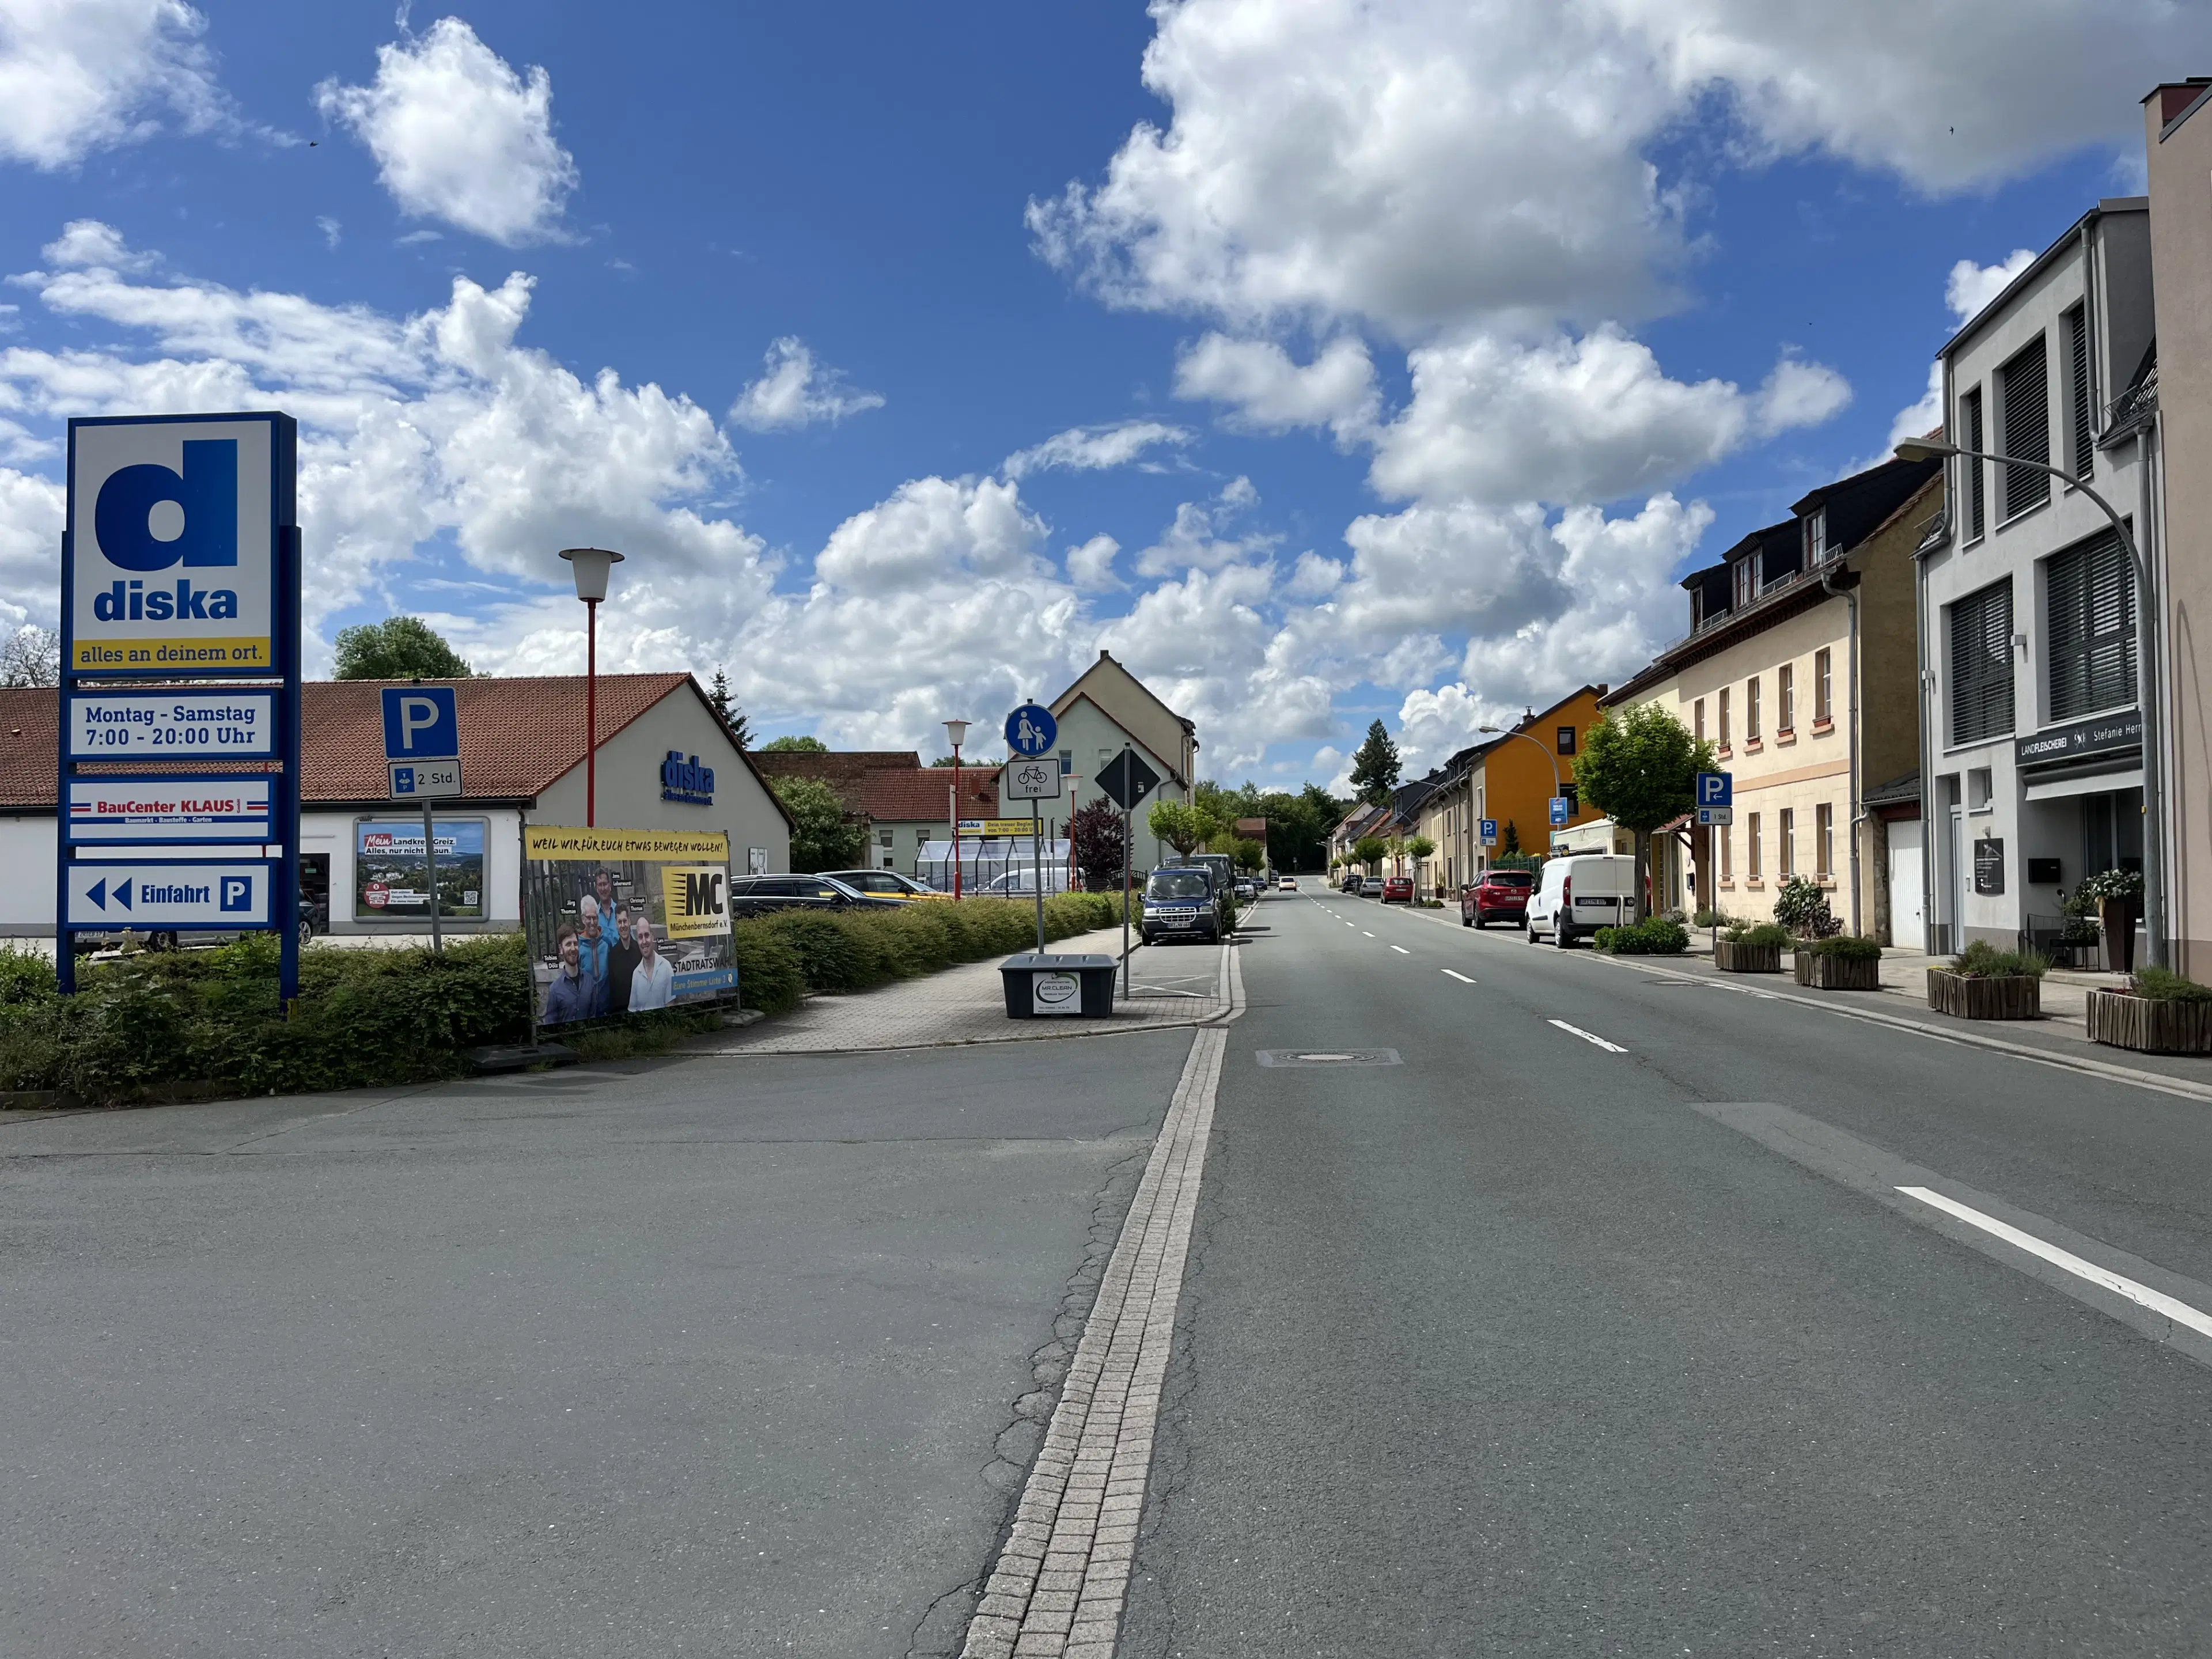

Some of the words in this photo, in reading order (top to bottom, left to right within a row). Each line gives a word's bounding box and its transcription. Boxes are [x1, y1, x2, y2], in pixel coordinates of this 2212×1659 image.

[95, 439, 237, 571] d
[94, 579, 237, 621] diska
[81, 647, 123, 662] alles
[129, 650, 150, 661] an
[157, 645, 226, 661] deinem
[232, 645, 262, 660] ort.
[86, 707, 154, 725] Montag
[173, 706, 255, 724] Samstag
[400, 697, 439, 749] P
[86, 729, 129, 745] 7:00
[153, 728, 209, 744] 20:00
[217, 728, 255, 744] Uhr
[2021, 737, 2067, 756] LANDFLEISCHEREI
[2094, 726, 2122, 741] Stefanie
[418, 774, 425, 785] 2
[432, 772, 456, 783] Std.
[661, 750, 714, 793] diska
[1025, 785, 1041, 793] frei
[1706, 777, 1724, 801] P
[97, 800, 176, 813] BauCenter
[181, 800, 234, 812] KLAUS
[1484, 822, 1493, 834] P
[366, 835, 391, 847] Mein
[533, 838, 558, 850] WEIL
[560, 838, 581, 851] WIR
[582, 836, 600, 851] FÜR
[601, 840, 623, 852] EUCH
[626, 841, 651, 852] ETWAS
[654, 841, 689, 854] BEWEGEN
[691, 842, 723, 853] WOLLEN!
[142, 885, 210, 903] Einfahrt
[227, 881, 245, 905] P
[685, 873, 723, 916] MC
[671, 920, 718, 931] Münchenbernsdorf
[719, 920, 728, 928] e.V.
[673, 956, 733, 973] STADTRATSWAHL
[673, 981, 685, 990] Eure
[687, 979, 707, 988] Stimme
[709, 977, 721, 985] Liste
